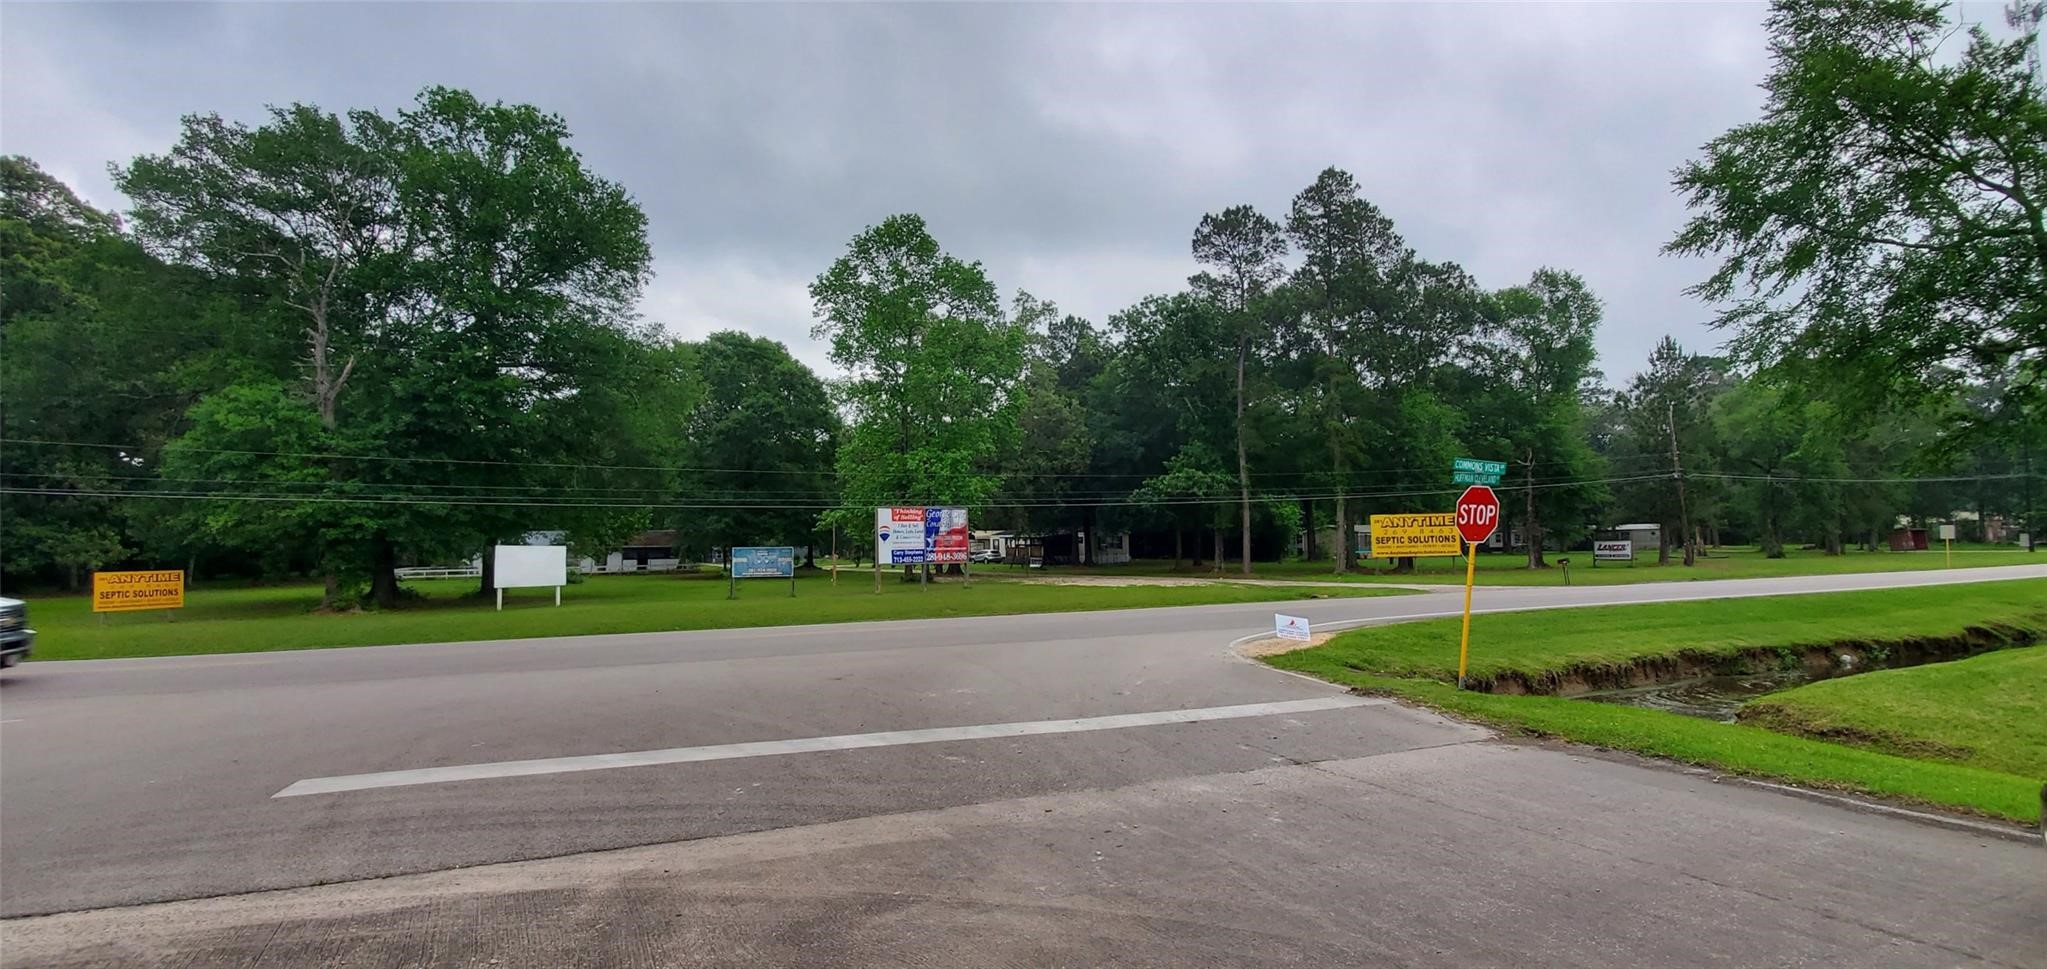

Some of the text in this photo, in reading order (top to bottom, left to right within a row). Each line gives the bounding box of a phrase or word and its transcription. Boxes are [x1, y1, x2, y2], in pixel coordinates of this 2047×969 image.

[1454, 460, 1483, 471] COMMONS
[1484, 463, 1500, 473] VISTA
[1455, 474, 1474, 483] HUFFMAN
[1475, 475, 1497, 484] CLEVELAND
[1458, 503, 1496, 526] STOP
[1381, 515, 1455, 528] ANYTIME
[1375, 534, 1456, 545] SEPTIC SOLUTIONS
[107, 572, 181, 584] ANYTIME
[99, 588, 179, 600] SEPTIC SOLUTIONS
